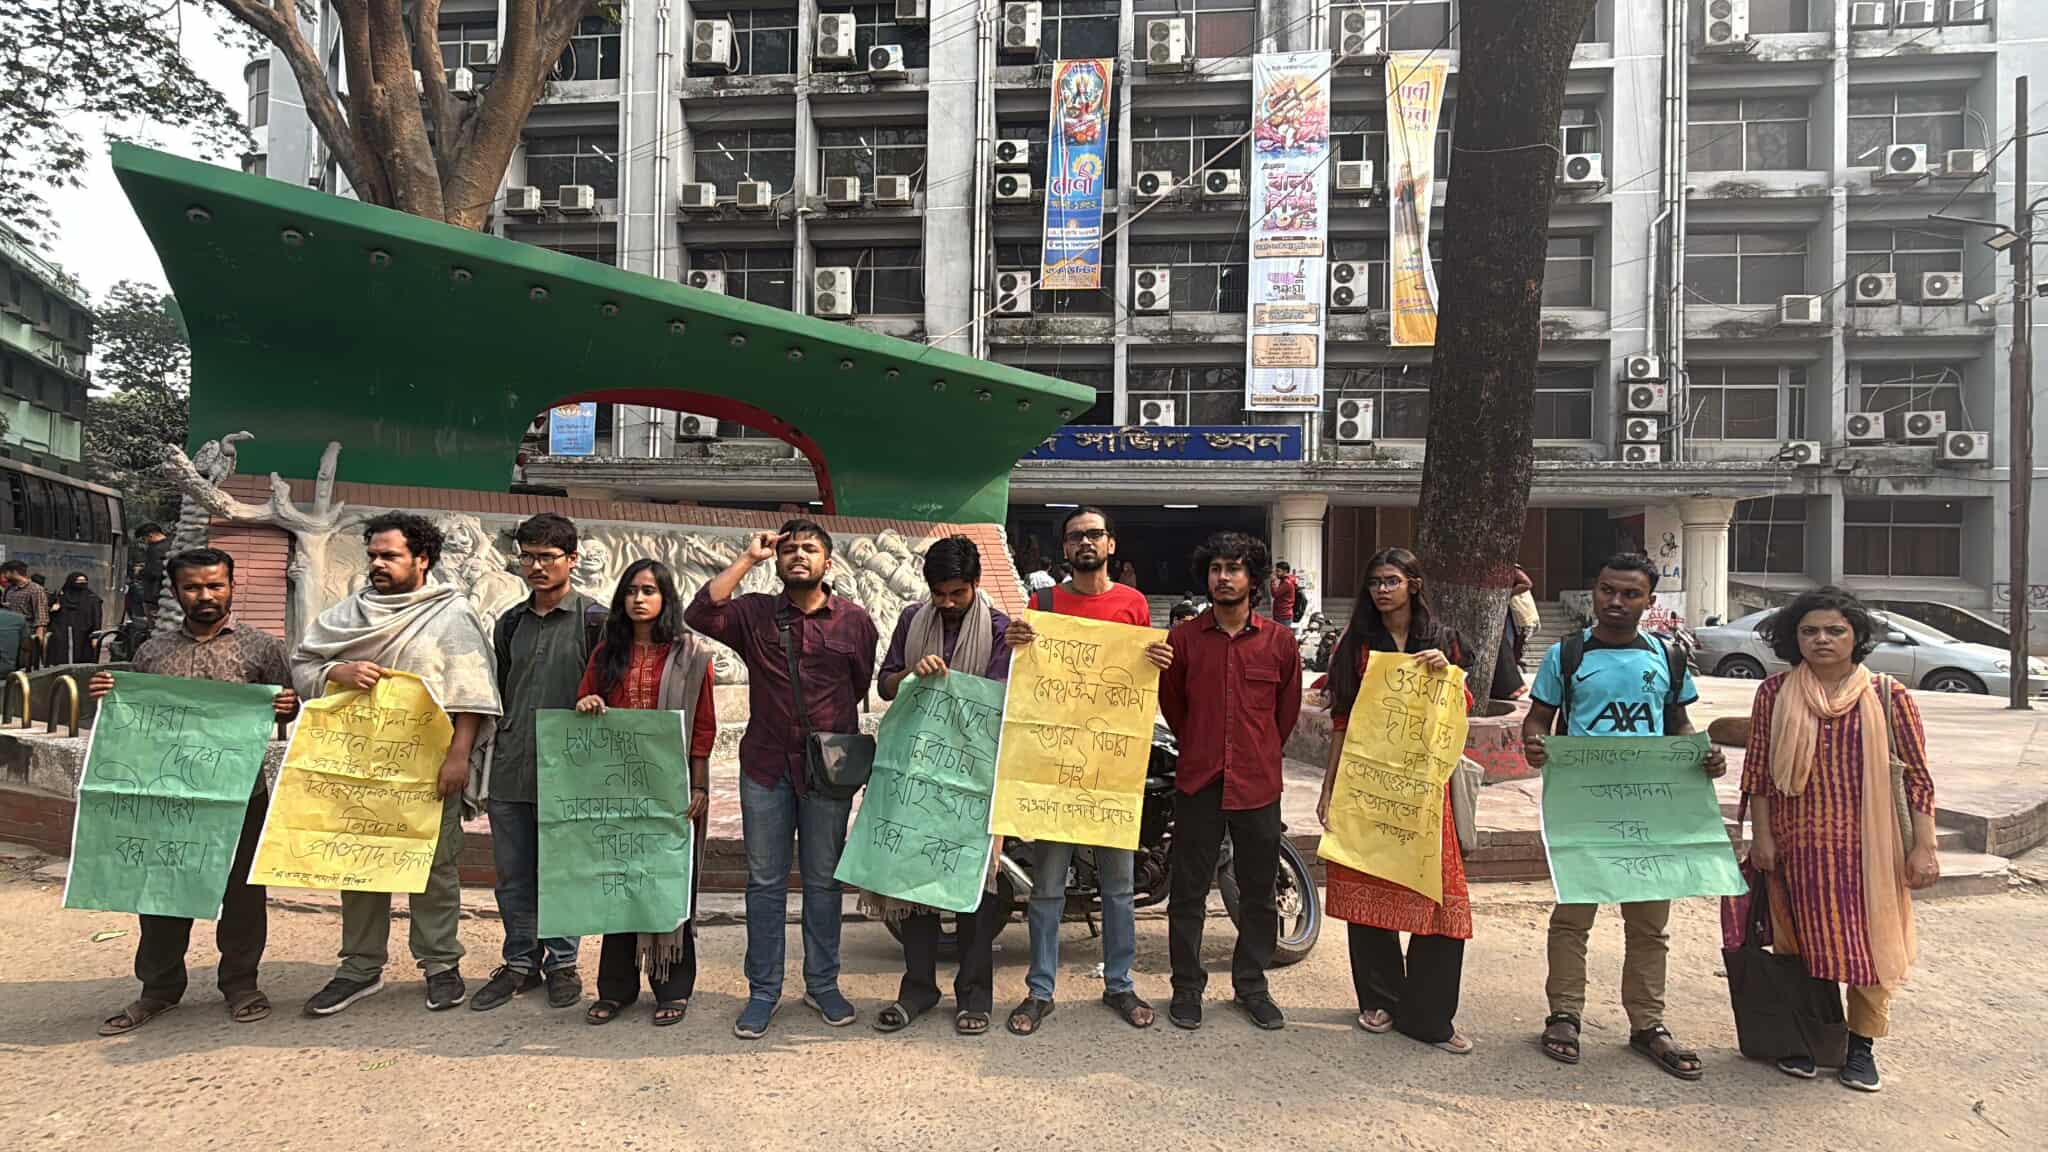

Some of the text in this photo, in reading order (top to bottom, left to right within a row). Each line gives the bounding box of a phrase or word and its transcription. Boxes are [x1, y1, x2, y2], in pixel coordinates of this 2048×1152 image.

[1202, 432, 1291, 455] ভবন
[1586, 701, 1656, 733] AXA
[373, 734, 425, 761] নারী
